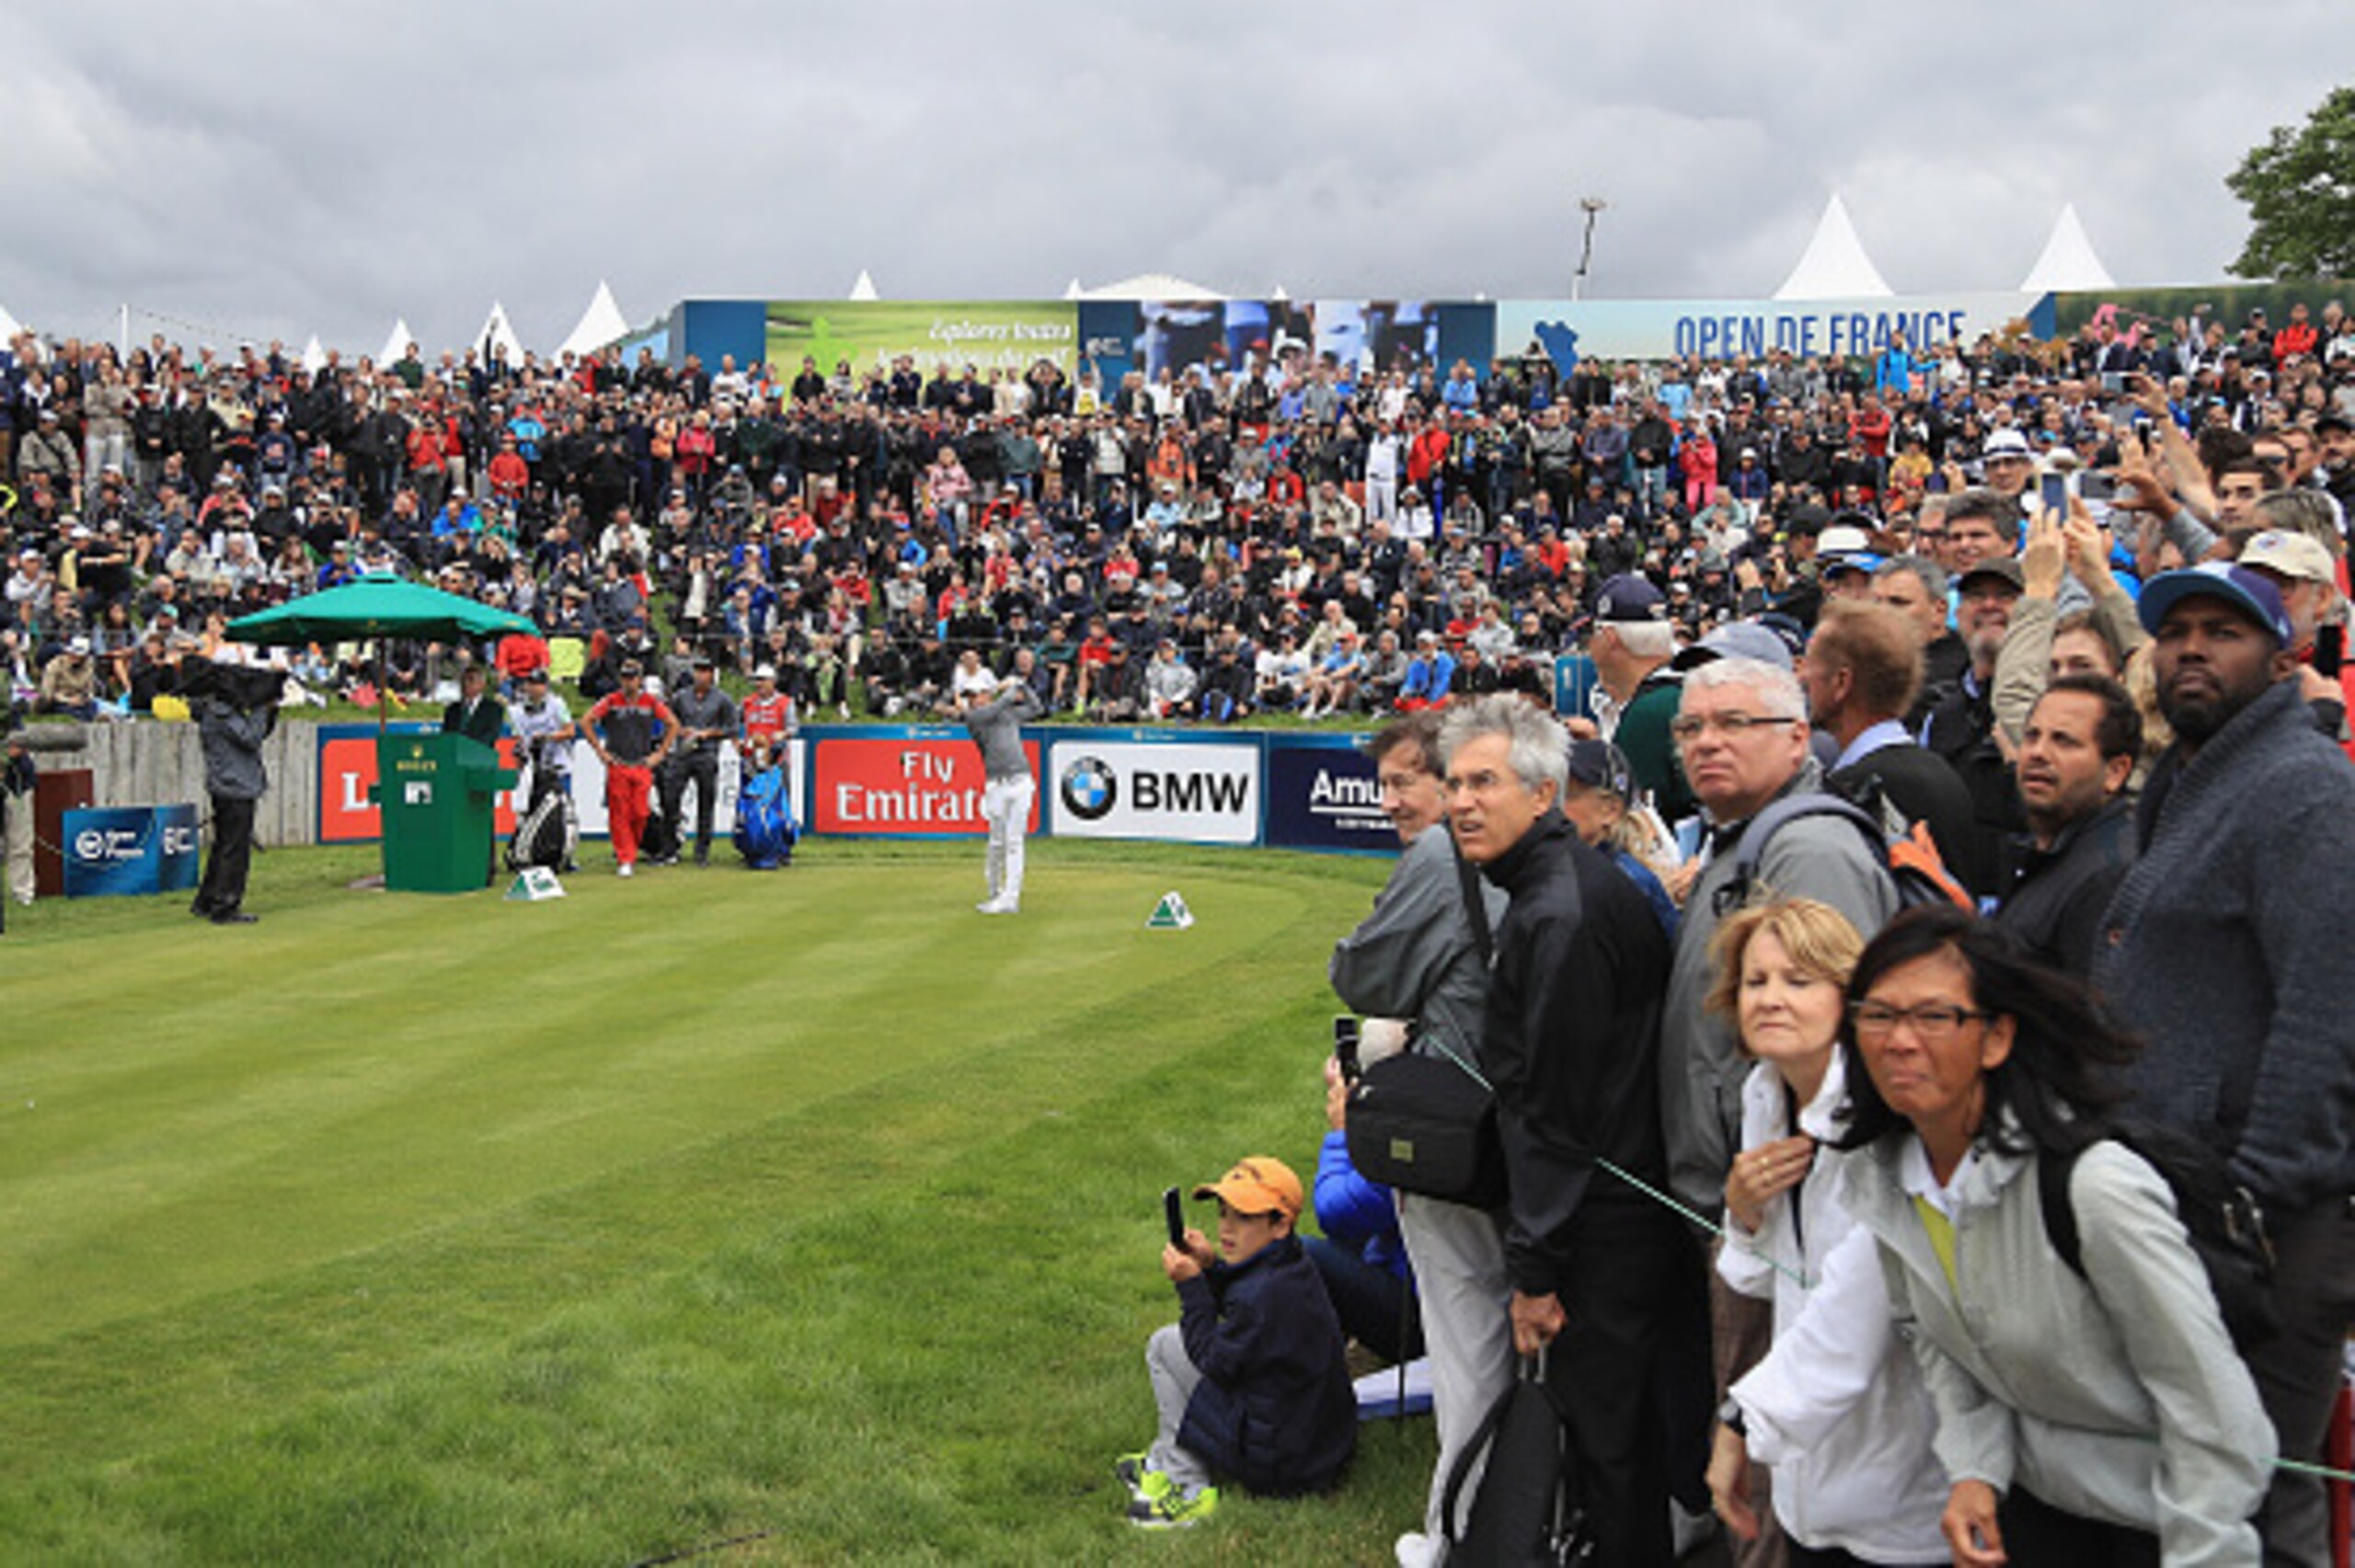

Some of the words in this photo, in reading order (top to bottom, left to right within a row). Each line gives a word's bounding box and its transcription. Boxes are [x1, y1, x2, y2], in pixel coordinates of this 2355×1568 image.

[1675, 315, 1763, 361] OPEN
[1776, 315, 1819, 357] DE
[1830, 310, 1966, 357] FRANCE
[903, 750, 955, 784] Fly
[1310, 769, 1385, 804] Amu
[835, 782, 991, 821] Emirat
[1132, 771, 1249, 814] BMW
